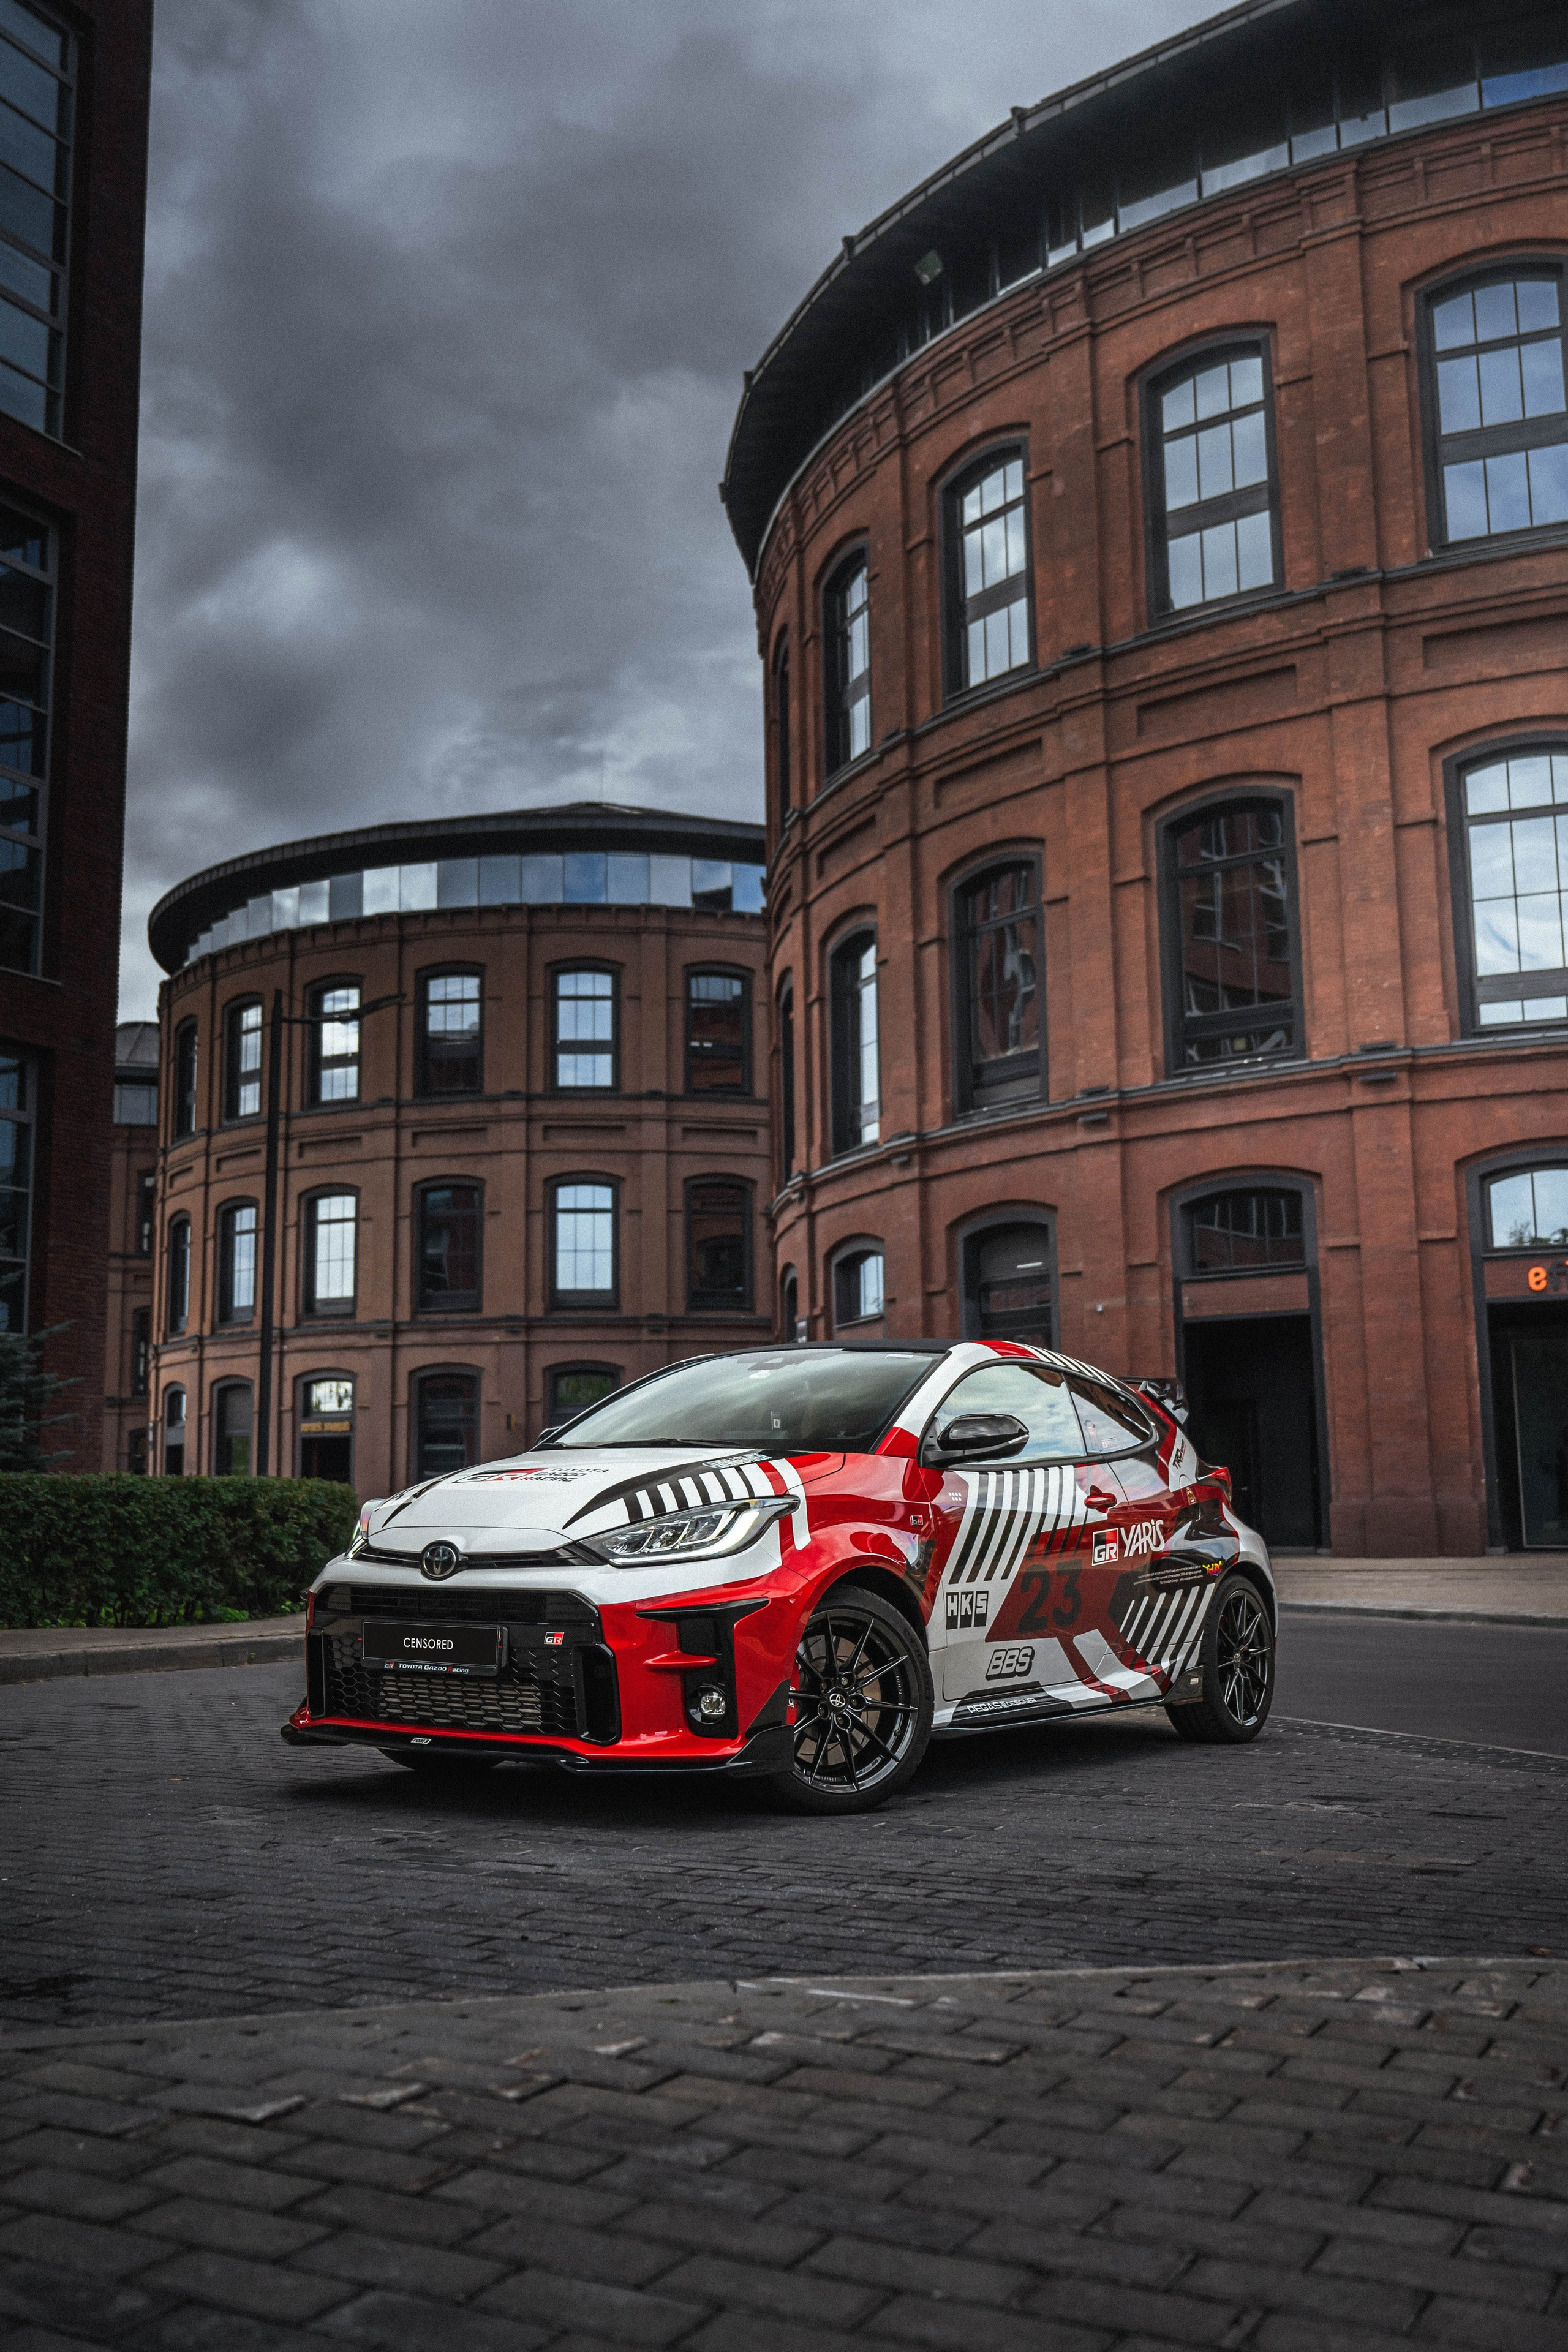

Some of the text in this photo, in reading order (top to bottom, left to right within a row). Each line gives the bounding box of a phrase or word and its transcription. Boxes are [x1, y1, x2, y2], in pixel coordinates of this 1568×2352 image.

[1094, 1542, 1117, 1562] GR
[946, 1591, 988, 1618] HKS
[1017, 1559, 1082, 1634] 23
[403, 1637, 453, 1650] CENSORED
[448, 1666, 469, 1675] Racing
[986, 1646, 1035, 1680] BBS
[967, 1697, 1038, 1713] PEGAS DESIGNER
